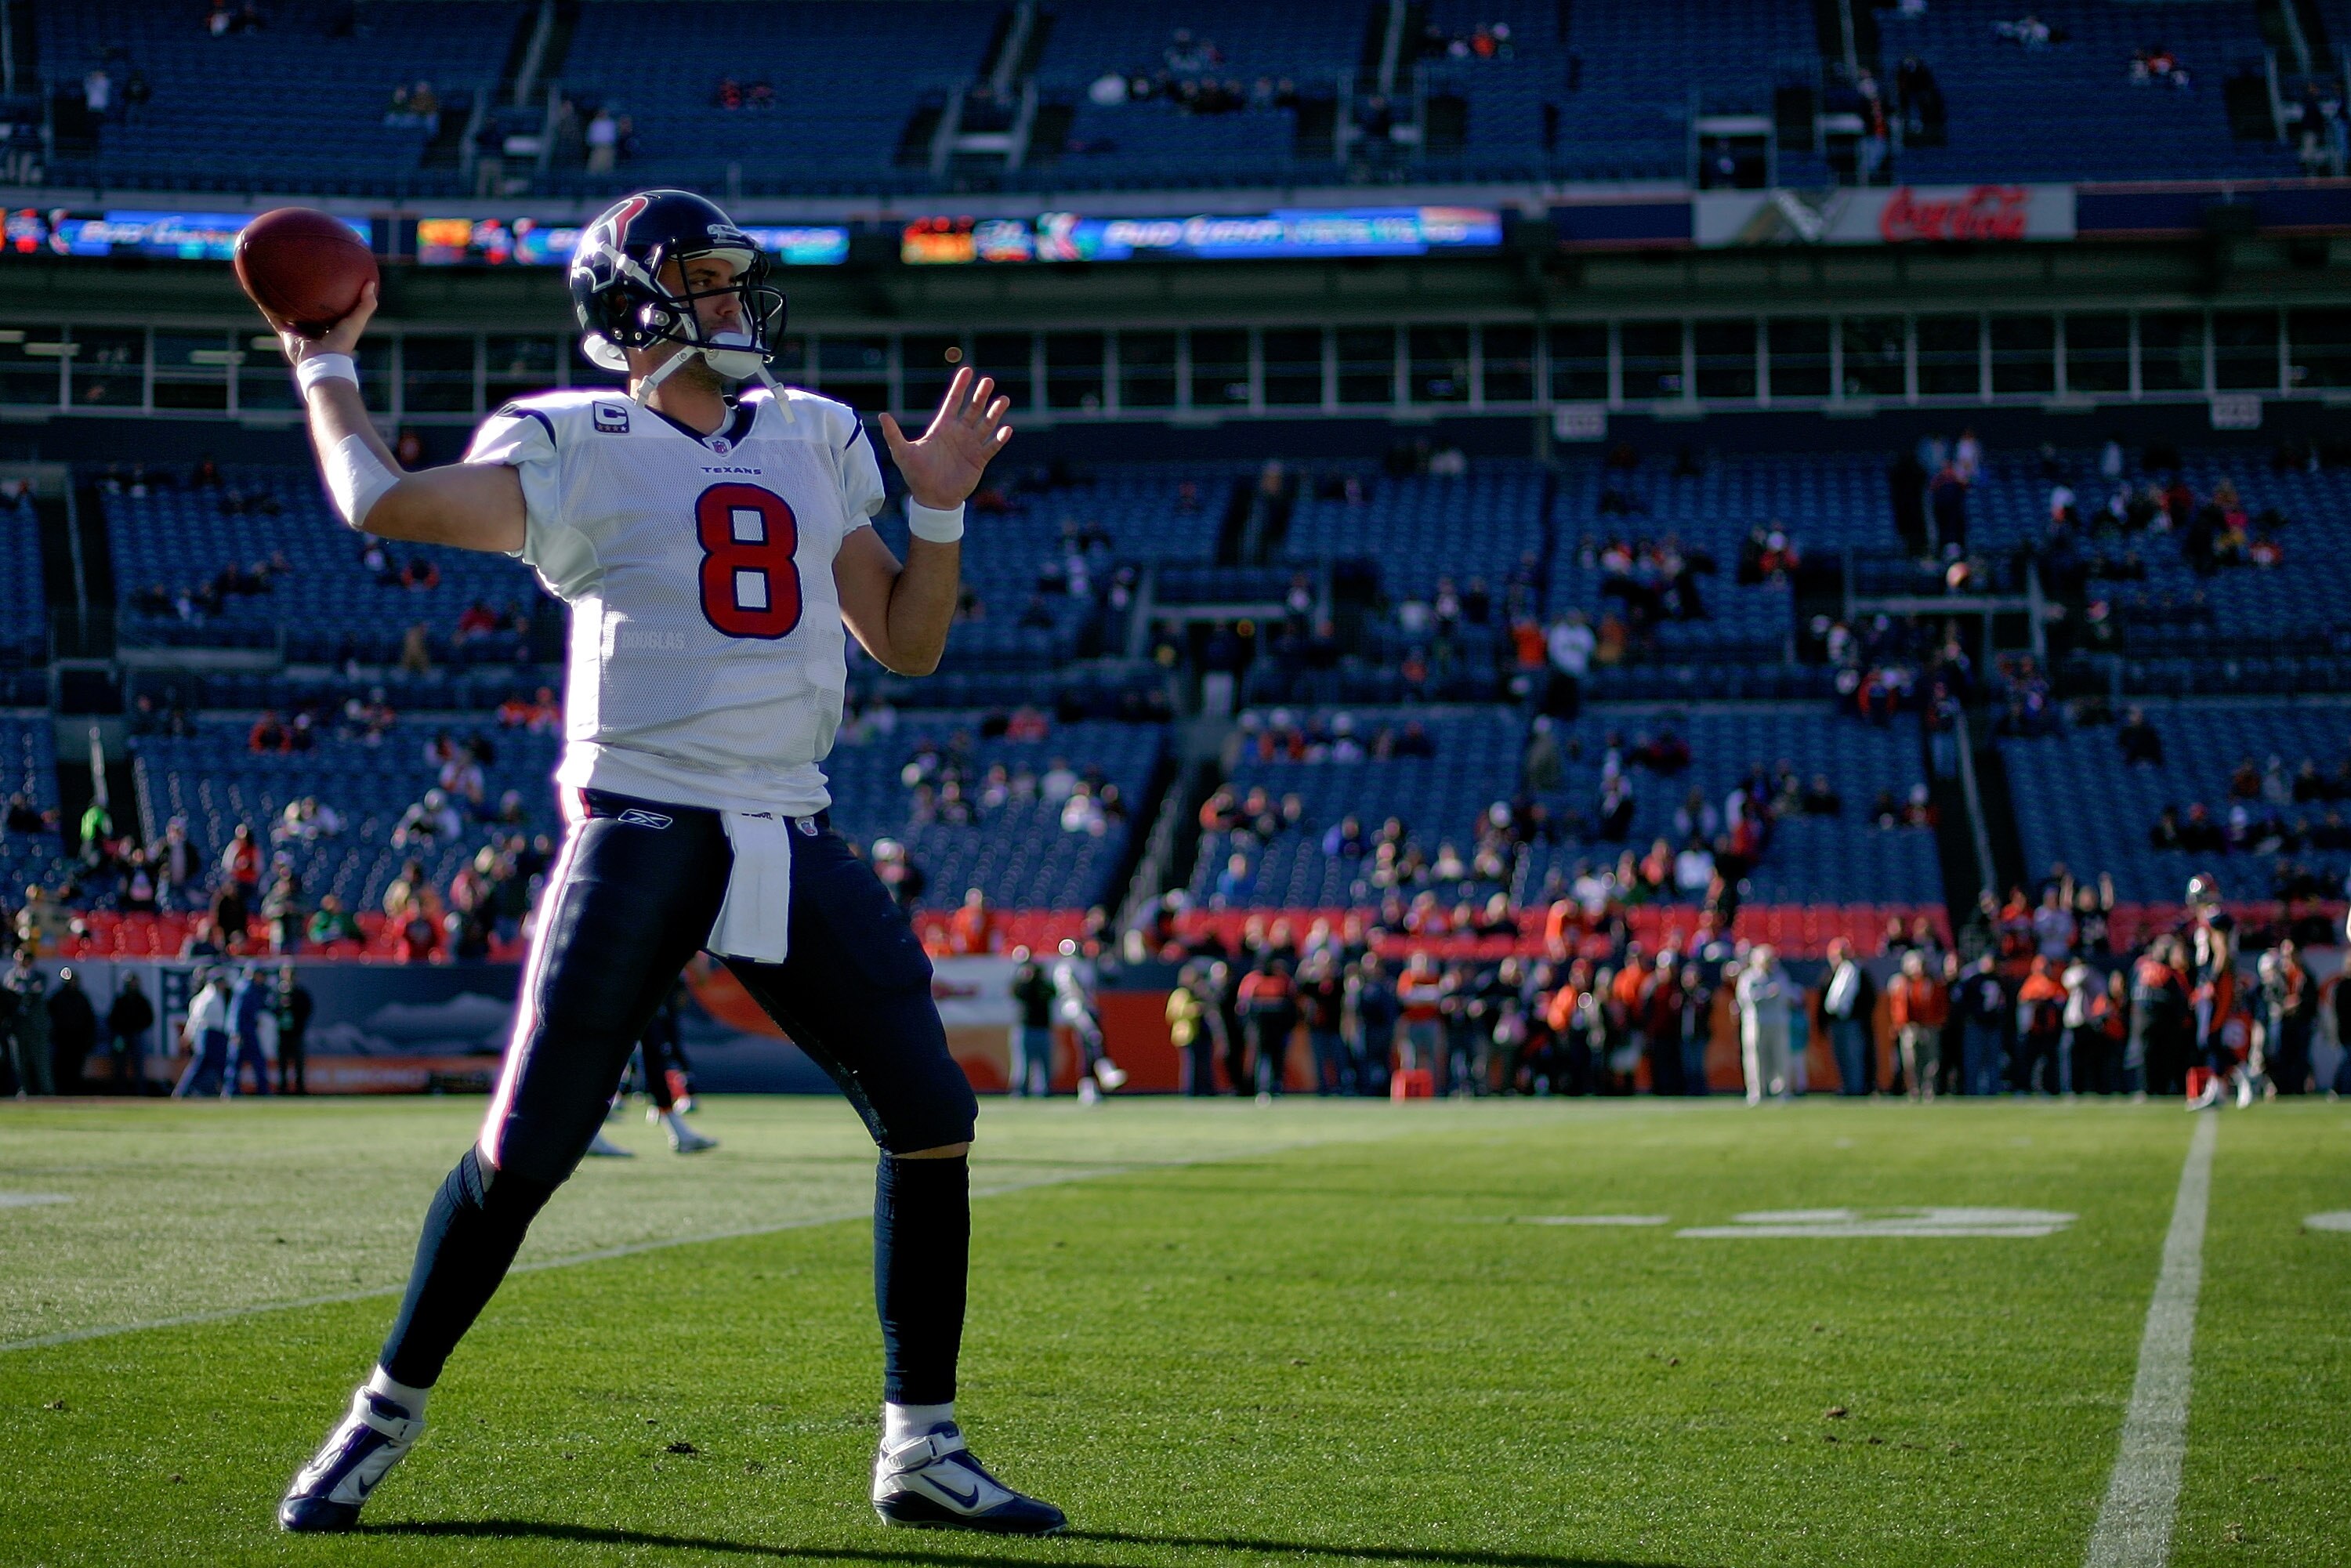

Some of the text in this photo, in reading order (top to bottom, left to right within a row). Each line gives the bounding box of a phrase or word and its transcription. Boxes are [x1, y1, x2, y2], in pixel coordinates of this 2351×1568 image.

[595, 402, 626, 425] C
[701, 466, 763, 475] TEXANS
[695, 482, 802, 640] 8
